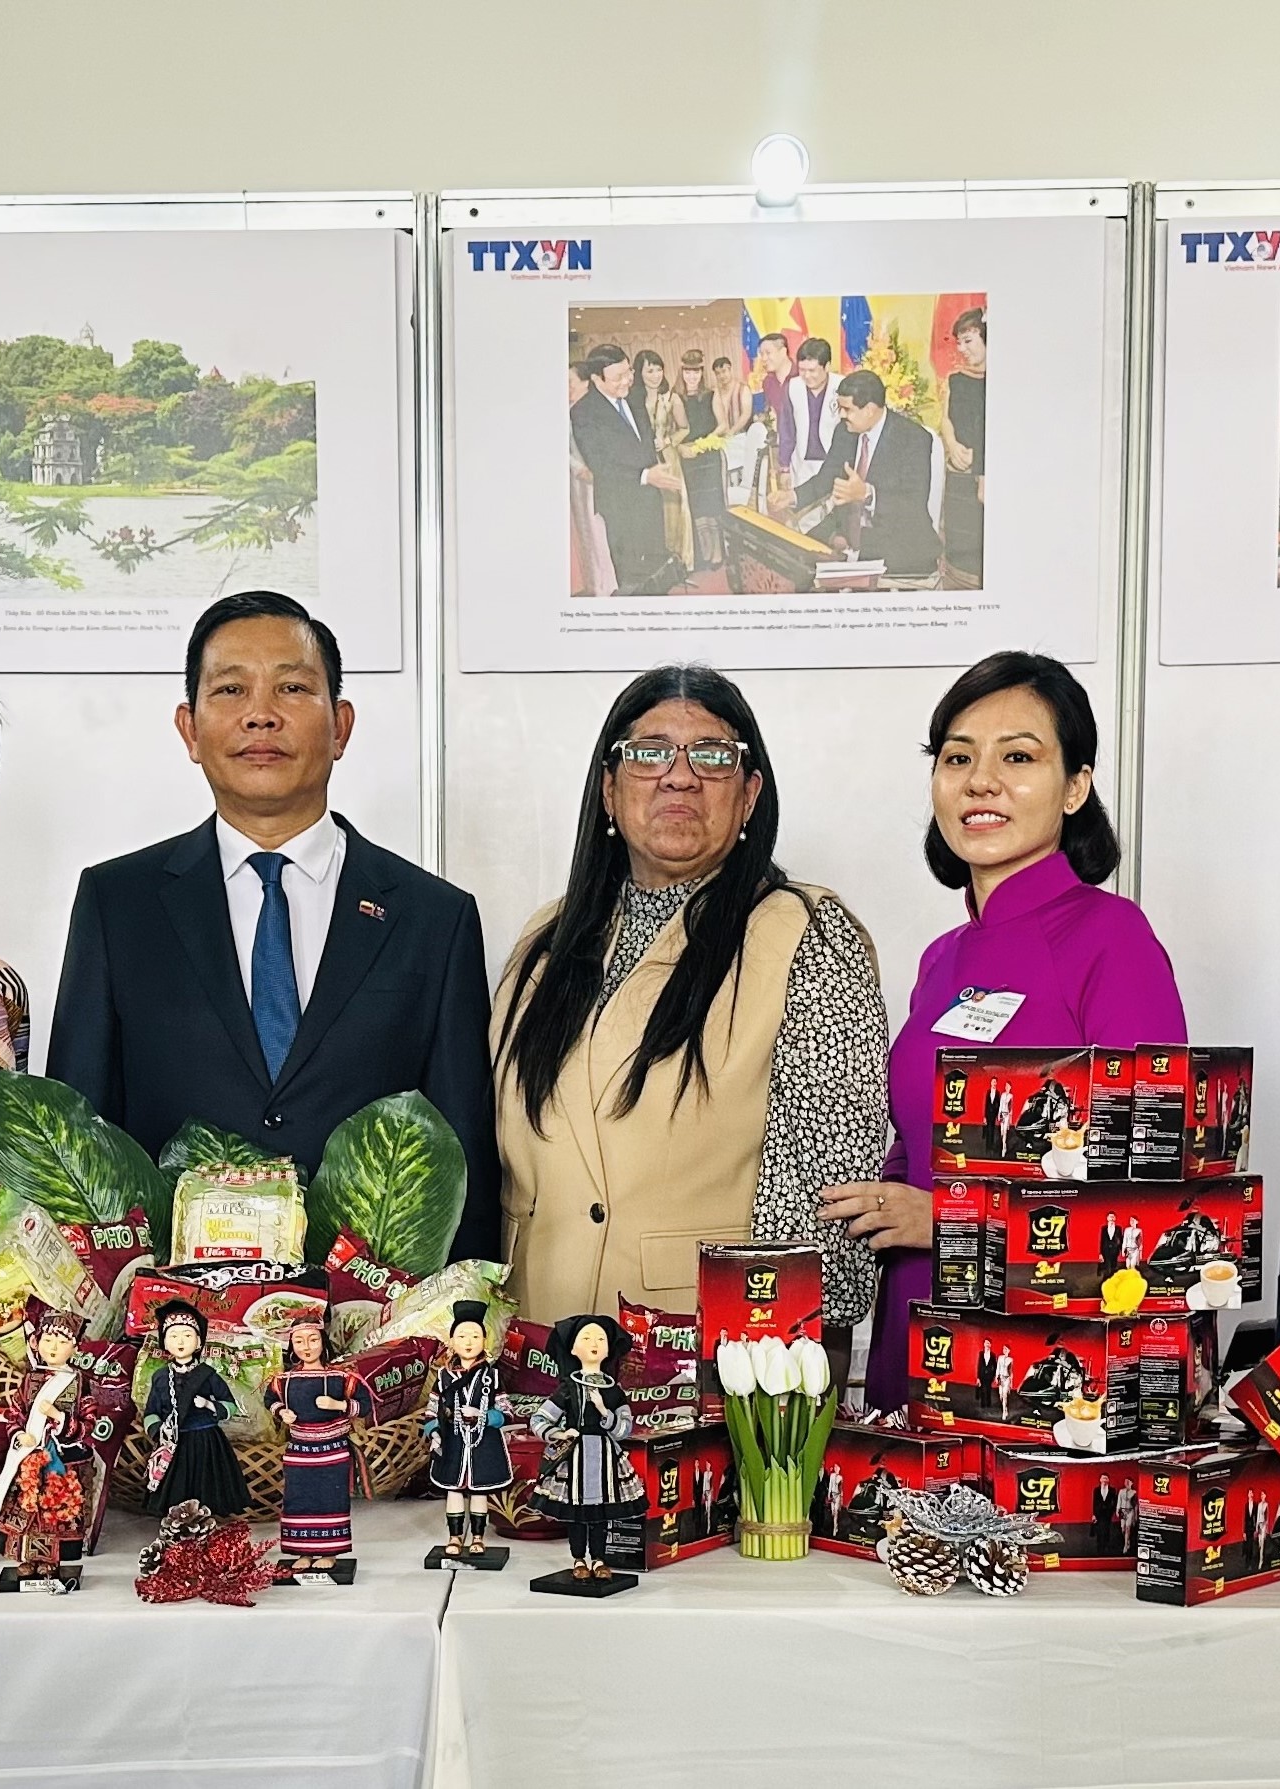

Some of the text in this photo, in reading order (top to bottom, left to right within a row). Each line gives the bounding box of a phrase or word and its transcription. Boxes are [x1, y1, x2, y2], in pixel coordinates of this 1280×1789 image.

[468, 240, 591, 271] TTXVN
[946, 1080, 966, 1100] G7
[1032, 1216, 1066, 1237] G7
[748, 1272, 776, 1289] G7
[926, 1336, 952, 1356] G7
[661, 1468, 677, 1490] G7
[1020, 1477, 1056, 1498] G7
[1203, 1498, 1224, 1522] G7
